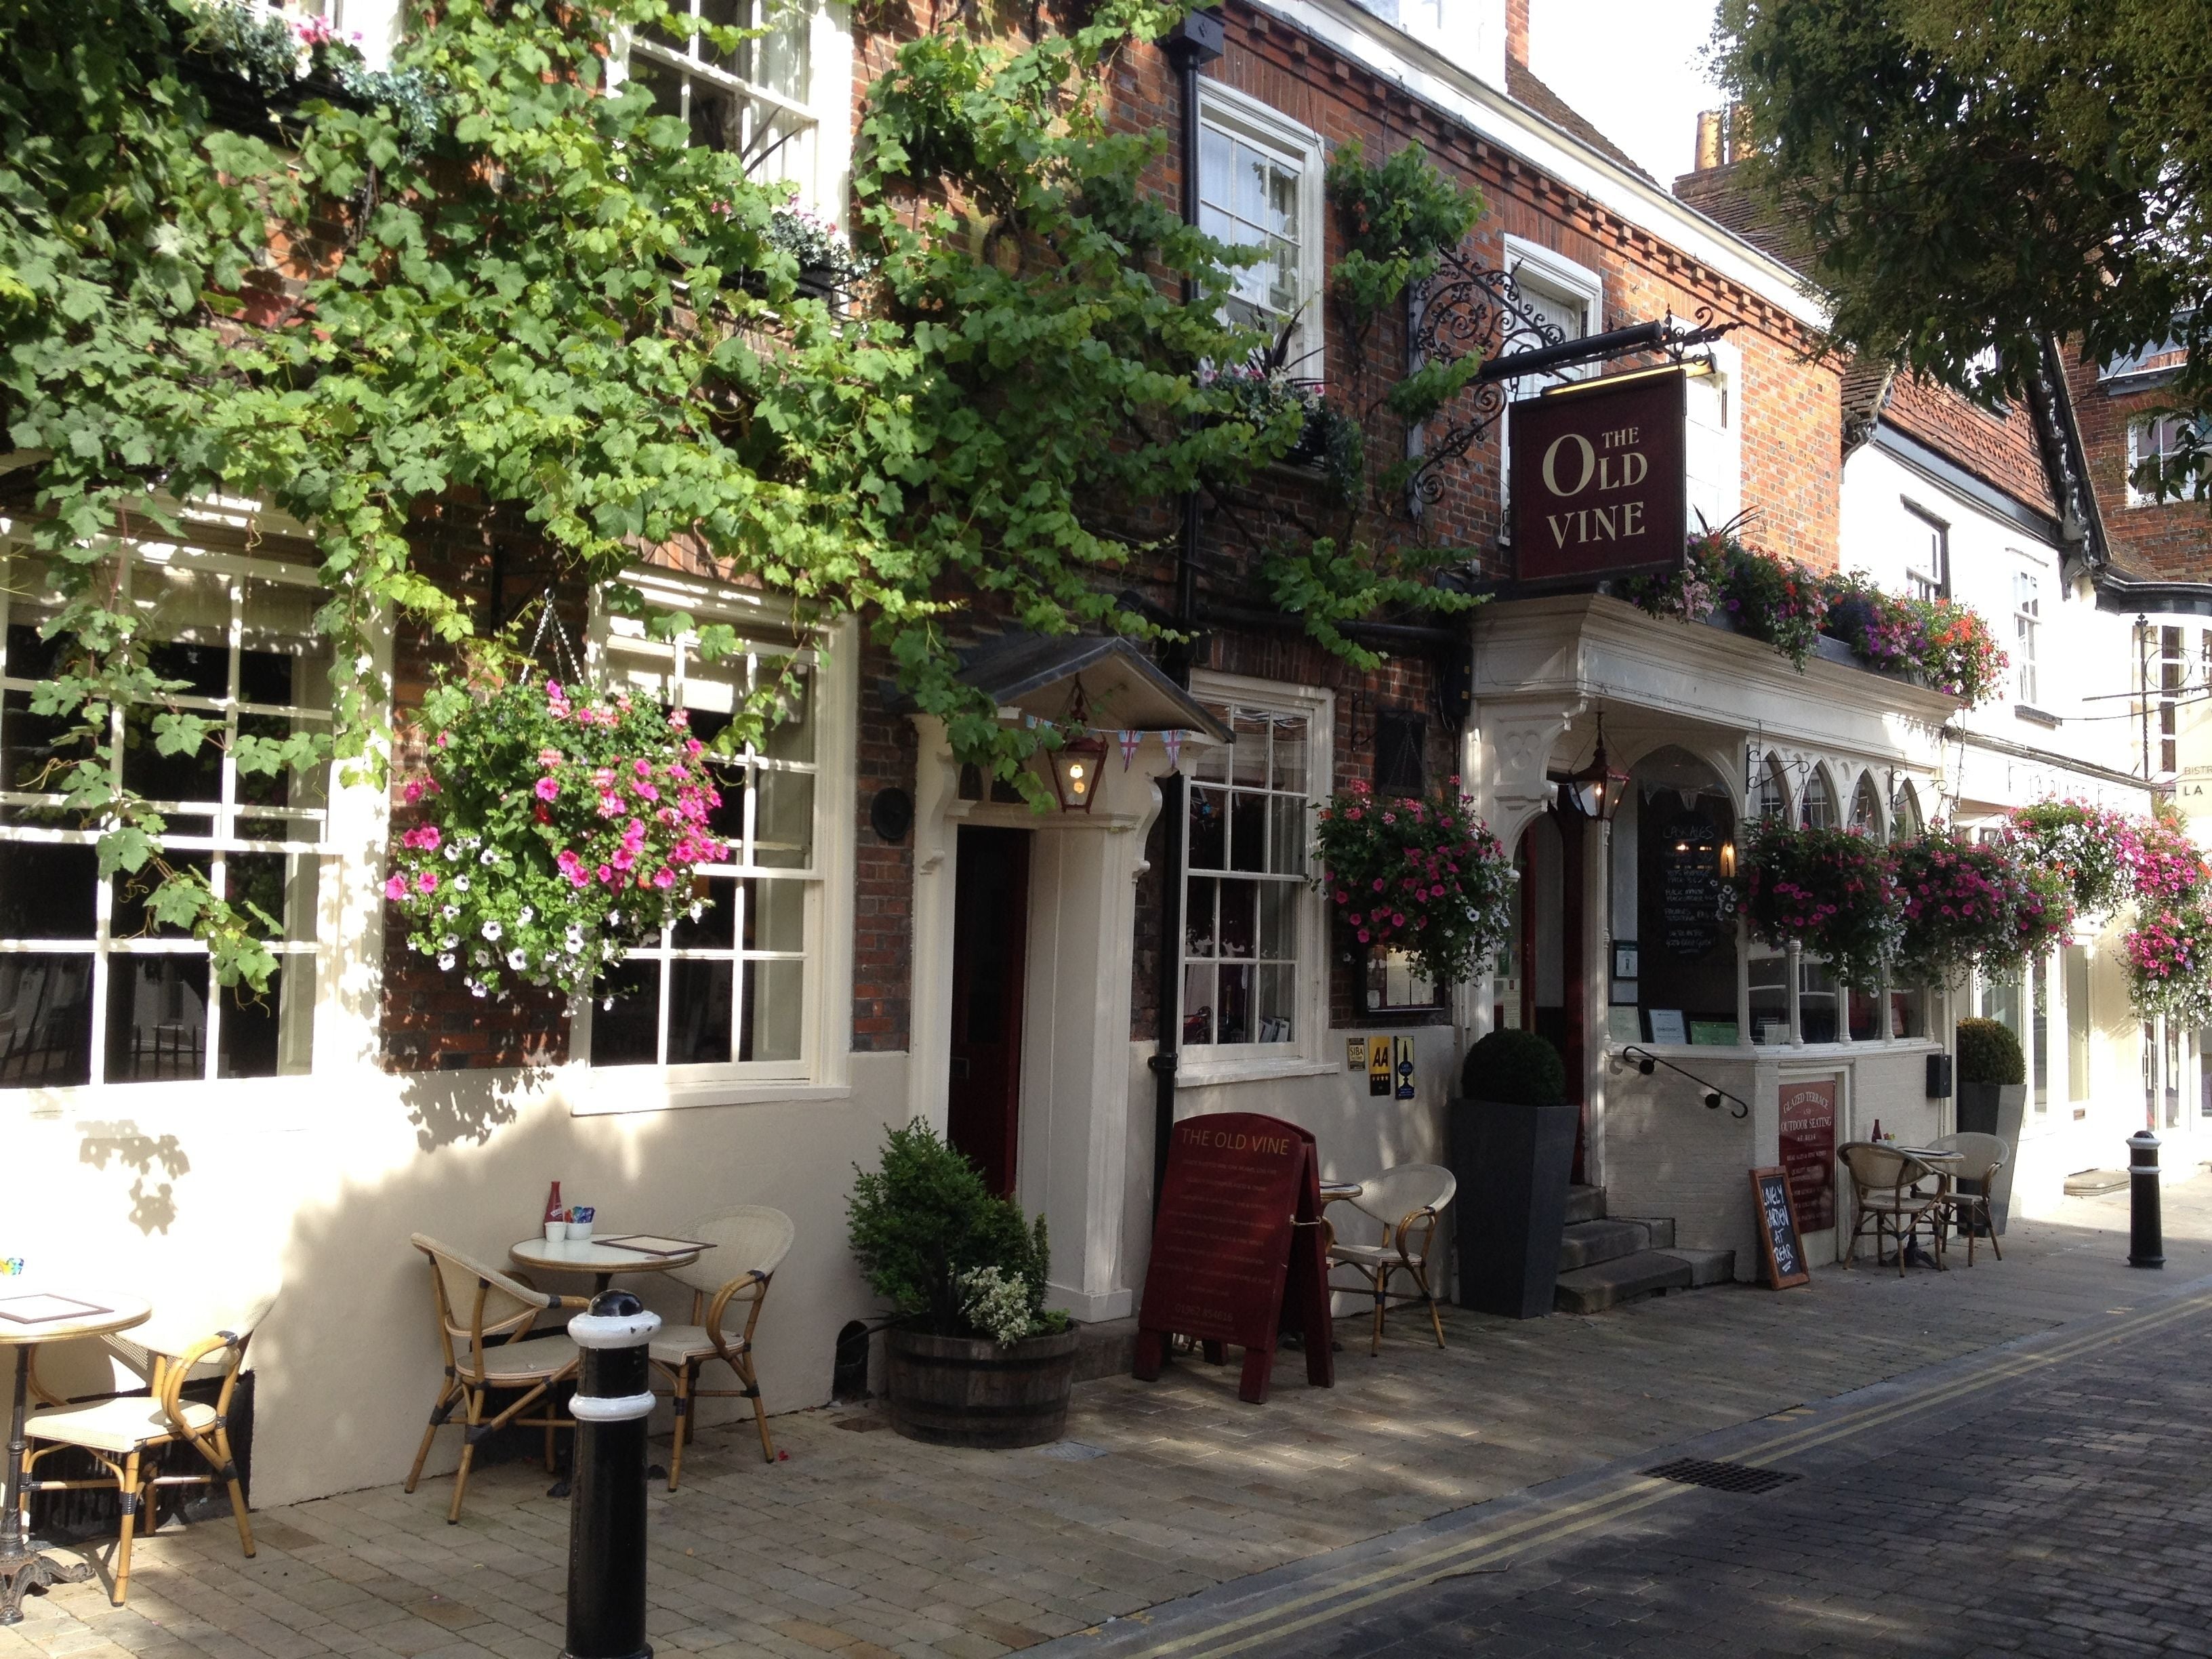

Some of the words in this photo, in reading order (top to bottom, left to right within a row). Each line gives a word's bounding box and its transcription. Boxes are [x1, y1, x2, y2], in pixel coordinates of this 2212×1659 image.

[1601, 426, 1639, 449] THE
[1542, 433, 1648, 497] OLD
[1546, 500, 1645, 550] VINE
[1350, 1046, 1364, 1056] SIBA
[1372, 1046, 1388, 1067] AA
[1783, 1092, 1805, 1113] GLAZED
[1805, 1091, 1829, 1110] TERRACE
[1781, 1119, 1807, 1132] OUTDOOR
[1809, 1116, 1832, 1129] SEATING
[1182, 1128, 1210, 1146] THE
[1214, 1132, 1247, 1150] OLD
[1252, 1135, 1290, 1155] VINE
[1761, 1184, 1784, 1206] LOVELY
[1774, 1228, 1784, 1244] AT
[1773, 1244, 1793, 1264] REAR
